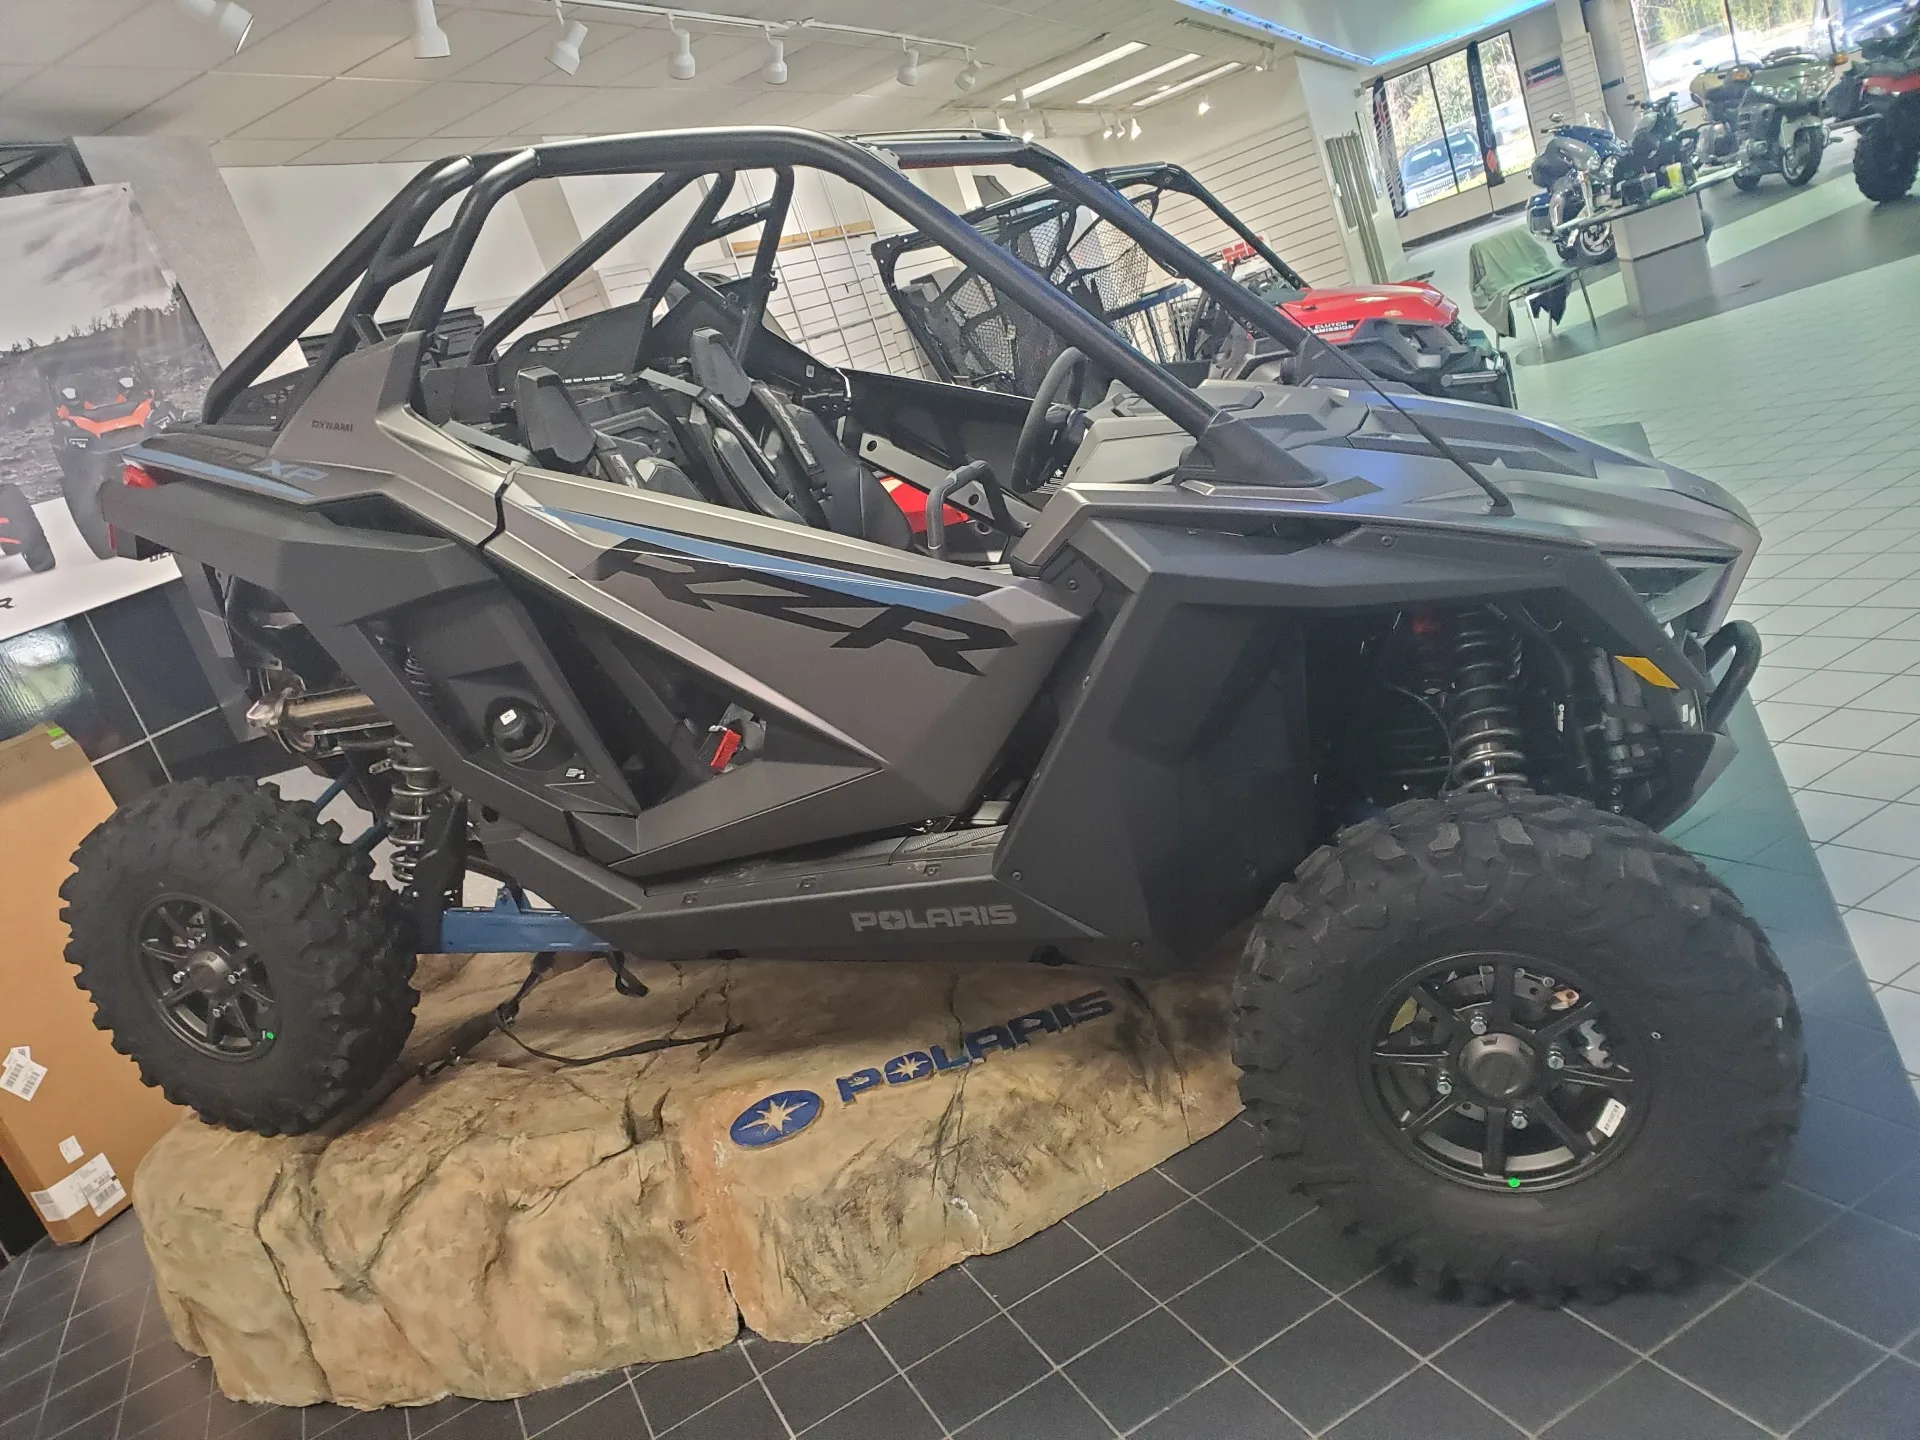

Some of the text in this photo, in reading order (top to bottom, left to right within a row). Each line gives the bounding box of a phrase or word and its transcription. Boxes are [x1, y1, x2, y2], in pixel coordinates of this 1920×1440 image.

[1314, 321, 1348, 331] CLUTCH
[578, 538, 1018, 677] RZR
[851, 904, 1018, 932] POLARIS
[836, 989, 1114, 1108] POLARIS
